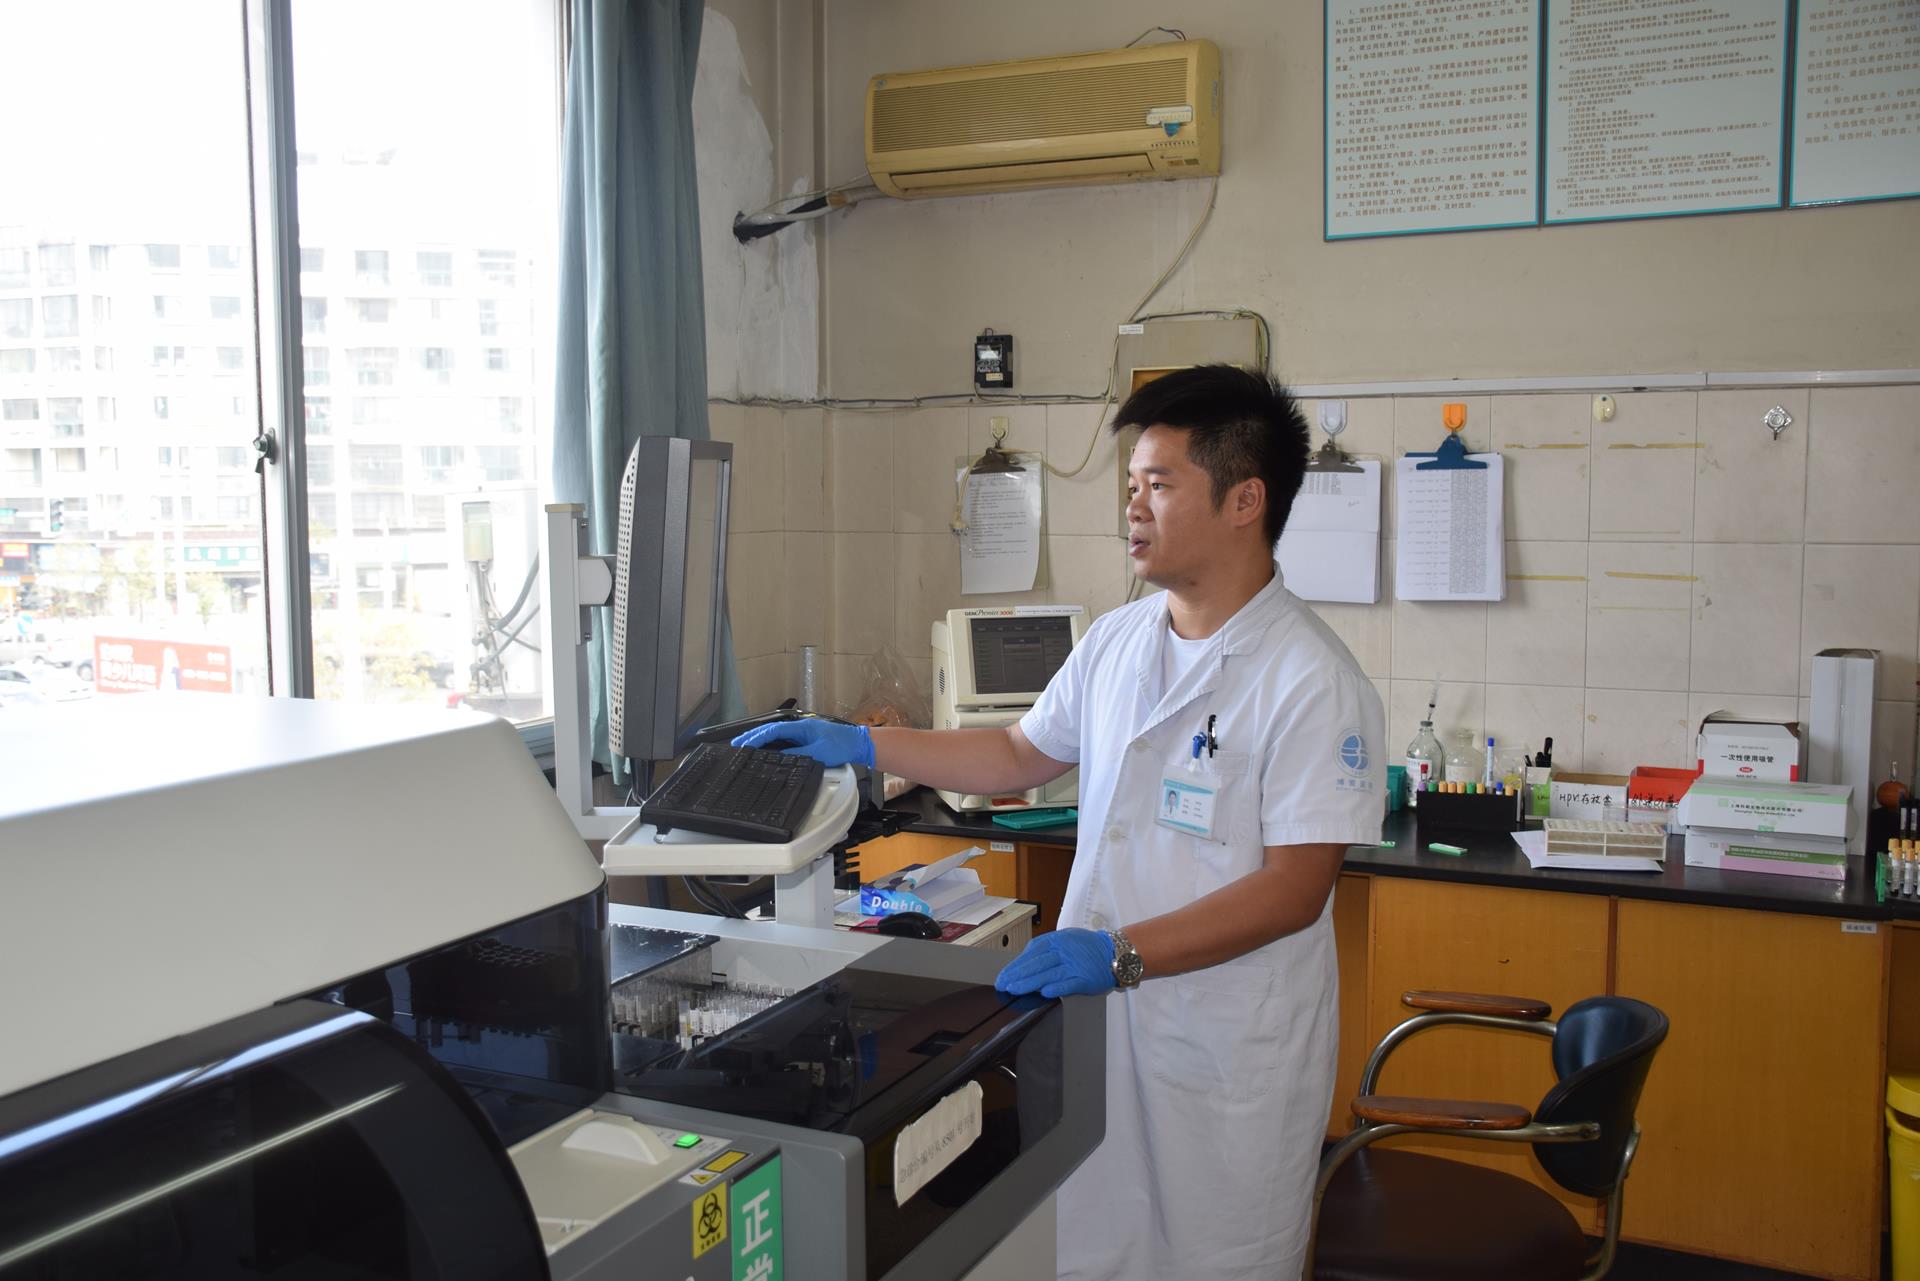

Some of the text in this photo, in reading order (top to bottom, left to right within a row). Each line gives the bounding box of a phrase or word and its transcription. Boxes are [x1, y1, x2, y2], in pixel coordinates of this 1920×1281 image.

[1720, 754, 1774, 764] 一次性使用吸管
[871, 895, 923, 913] Double
